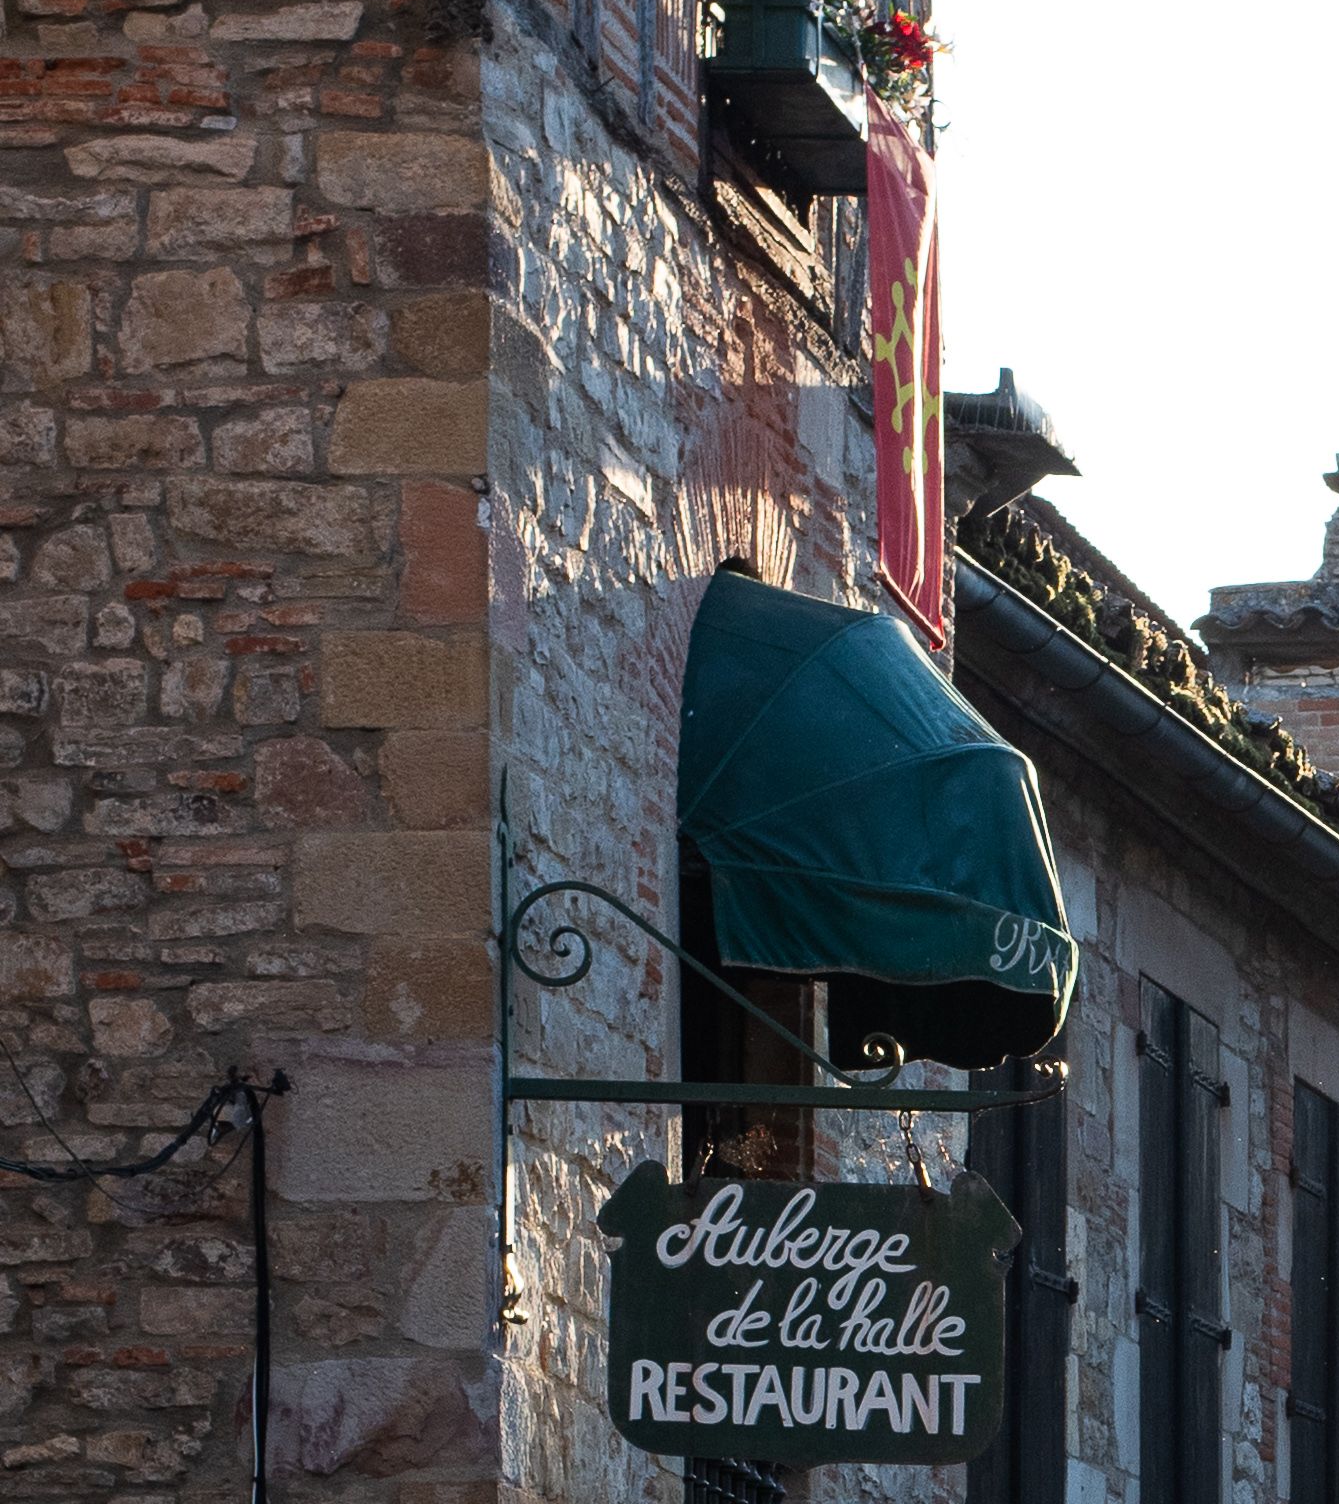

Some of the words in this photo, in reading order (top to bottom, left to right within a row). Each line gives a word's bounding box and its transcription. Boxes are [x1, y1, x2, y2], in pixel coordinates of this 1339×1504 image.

[656, 1183, 919, 1311] Auberge
[707, 1278, 772, 1348] de
[779, 1276, 832, 1349] la
[839, 1276, 967, 1356] halle
[629, 1358, 982, 1436] RESTAURANT
